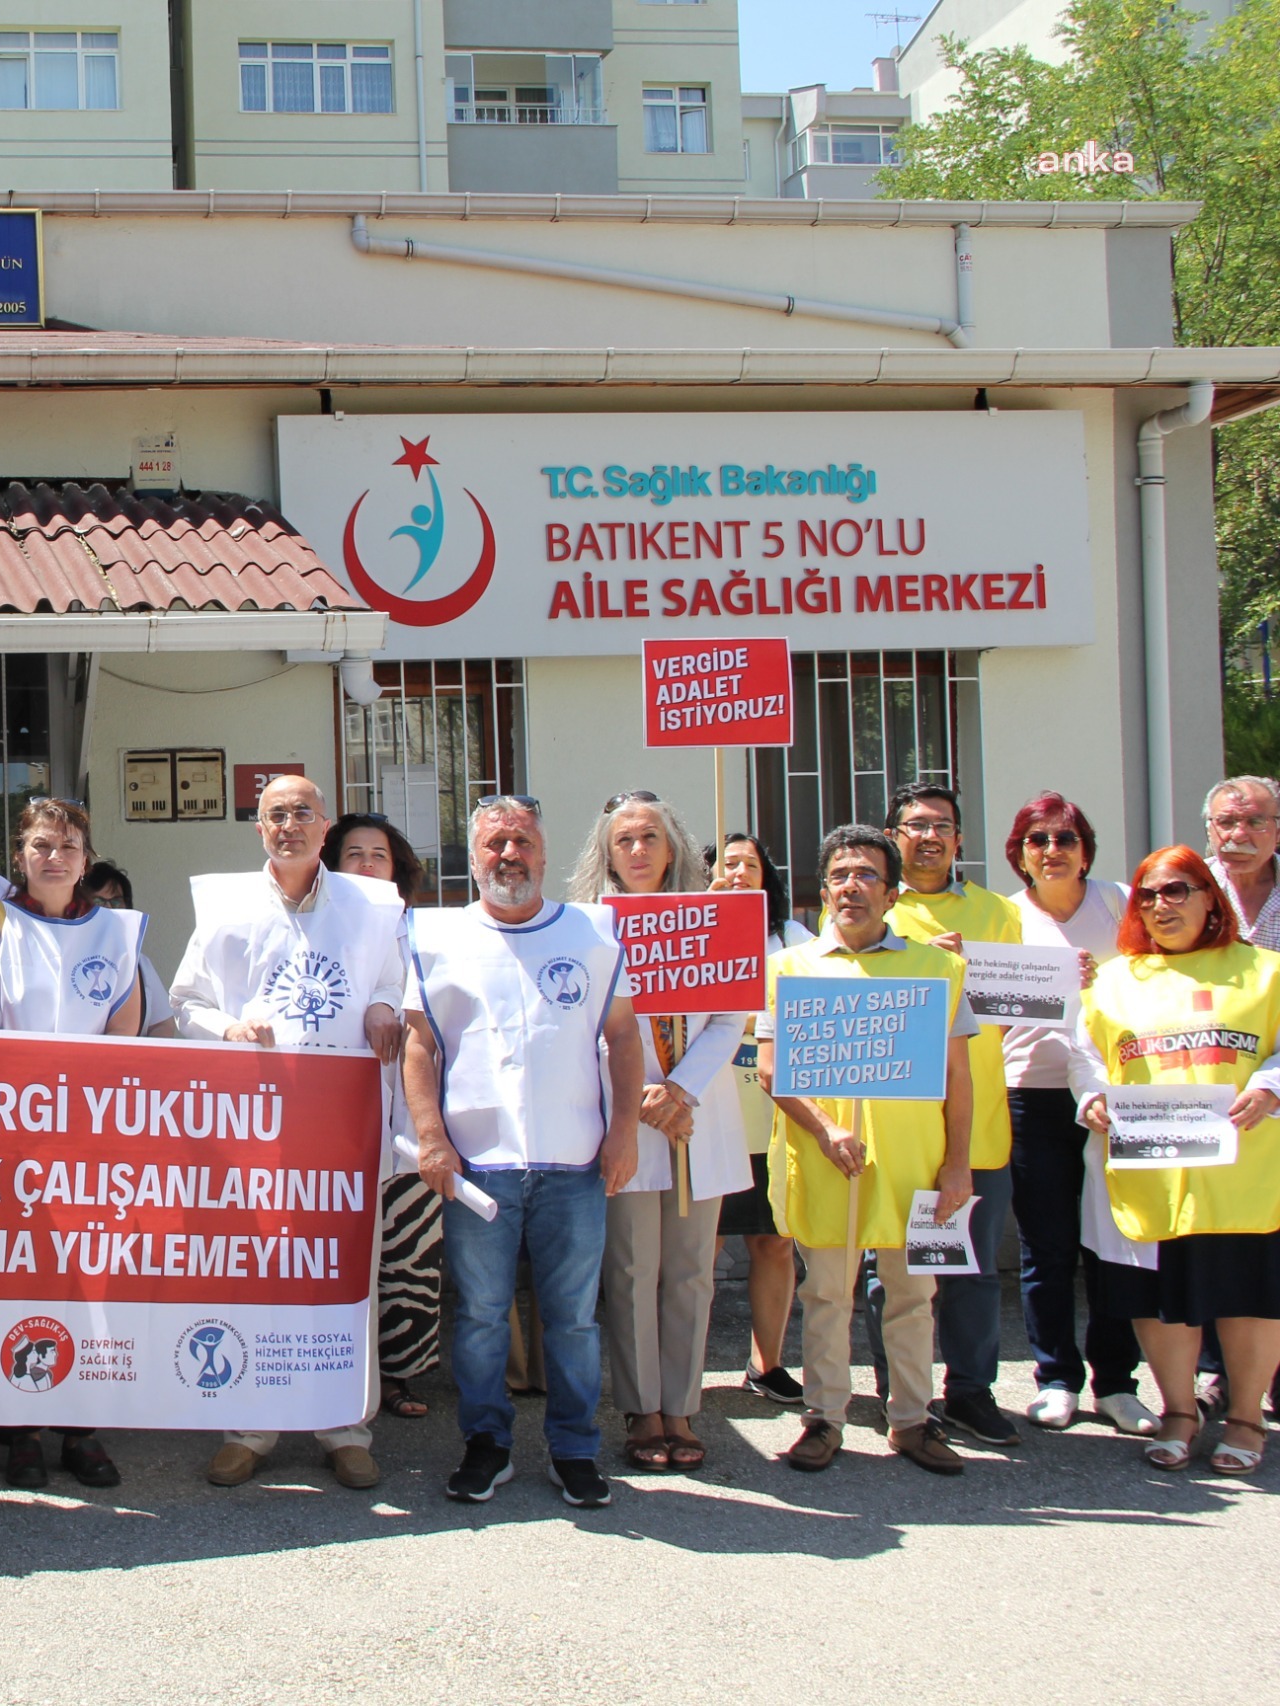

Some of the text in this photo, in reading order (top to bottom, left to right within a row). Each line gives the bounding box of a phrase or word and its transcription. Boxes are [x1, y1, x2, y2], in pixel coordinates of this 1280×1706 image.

[139, 461, 153, 471] 444
[156, 462, 160, 471] 1
[541, 463, 878, 506] T.C. Sağlık Bakanlığı
[545, 517, 926, 562] BATIKENT 5 NO'LU
[547, 564, 1048, 619] AİLE SAĞLIĞI MERKEZİ
[652, 647, 749, 680] VERGİDE
[656, 674, 742, 706] ADALET
[659, 694, 784, 732] İSTİYORUZ!
[254, 773, 285, 799] 3
[263, 959, 293, 1004] ANKARA
[295, 950, 328, 964] TABİP
[630, 957, 758, 998] STİYORUZ!
[967, 958, 1061, 973] Aile hekimliği çalışanları
[968, 970, 1054, 985] vergide adalet istiyor!
[783, 984, 932, 1020] HER AY SABİT
[786, 1010, 907, 1043] %15 VERGİ
[788, 1035, 895, 1067] KESİNTİSİ
[744, 1073, 760, 1083] SE
[790, 1060, 913, 1092] İSTİYORUZ!
[83, 1076, 283, 1142] YÜKÜNÜ
[1114, 1100, 1213, 1112] Aile hekimliği çalışanları
[1117, 1113, 1207, 1124] vergide adalet istiyor!
[13, 1158, 365, 1221] ÇALIŞANLARININ
[918, 1203, 936, 1215] Yükse
[944, 1219, 957, 1230] son!
[50, 1222, 340, 1280] YÜKLEMEYİN!
[81, 1337, 135, 1350] DEVRİMCİ
[255, 1332, 353, 1344] SAĞLIK VE SOSYAL
[79, 1353, 133, 1369] SAĞLIK İŞ
[255, 1344, 355, 1360] HİZMET EMEKÇİLERİ
[78, 1369, 137, 1382] SENDİKASI
[255, 1360, 354, 1372] SENDİKASI ANKARA
[255, 1374, 291, 1388] ŞUBESİ
